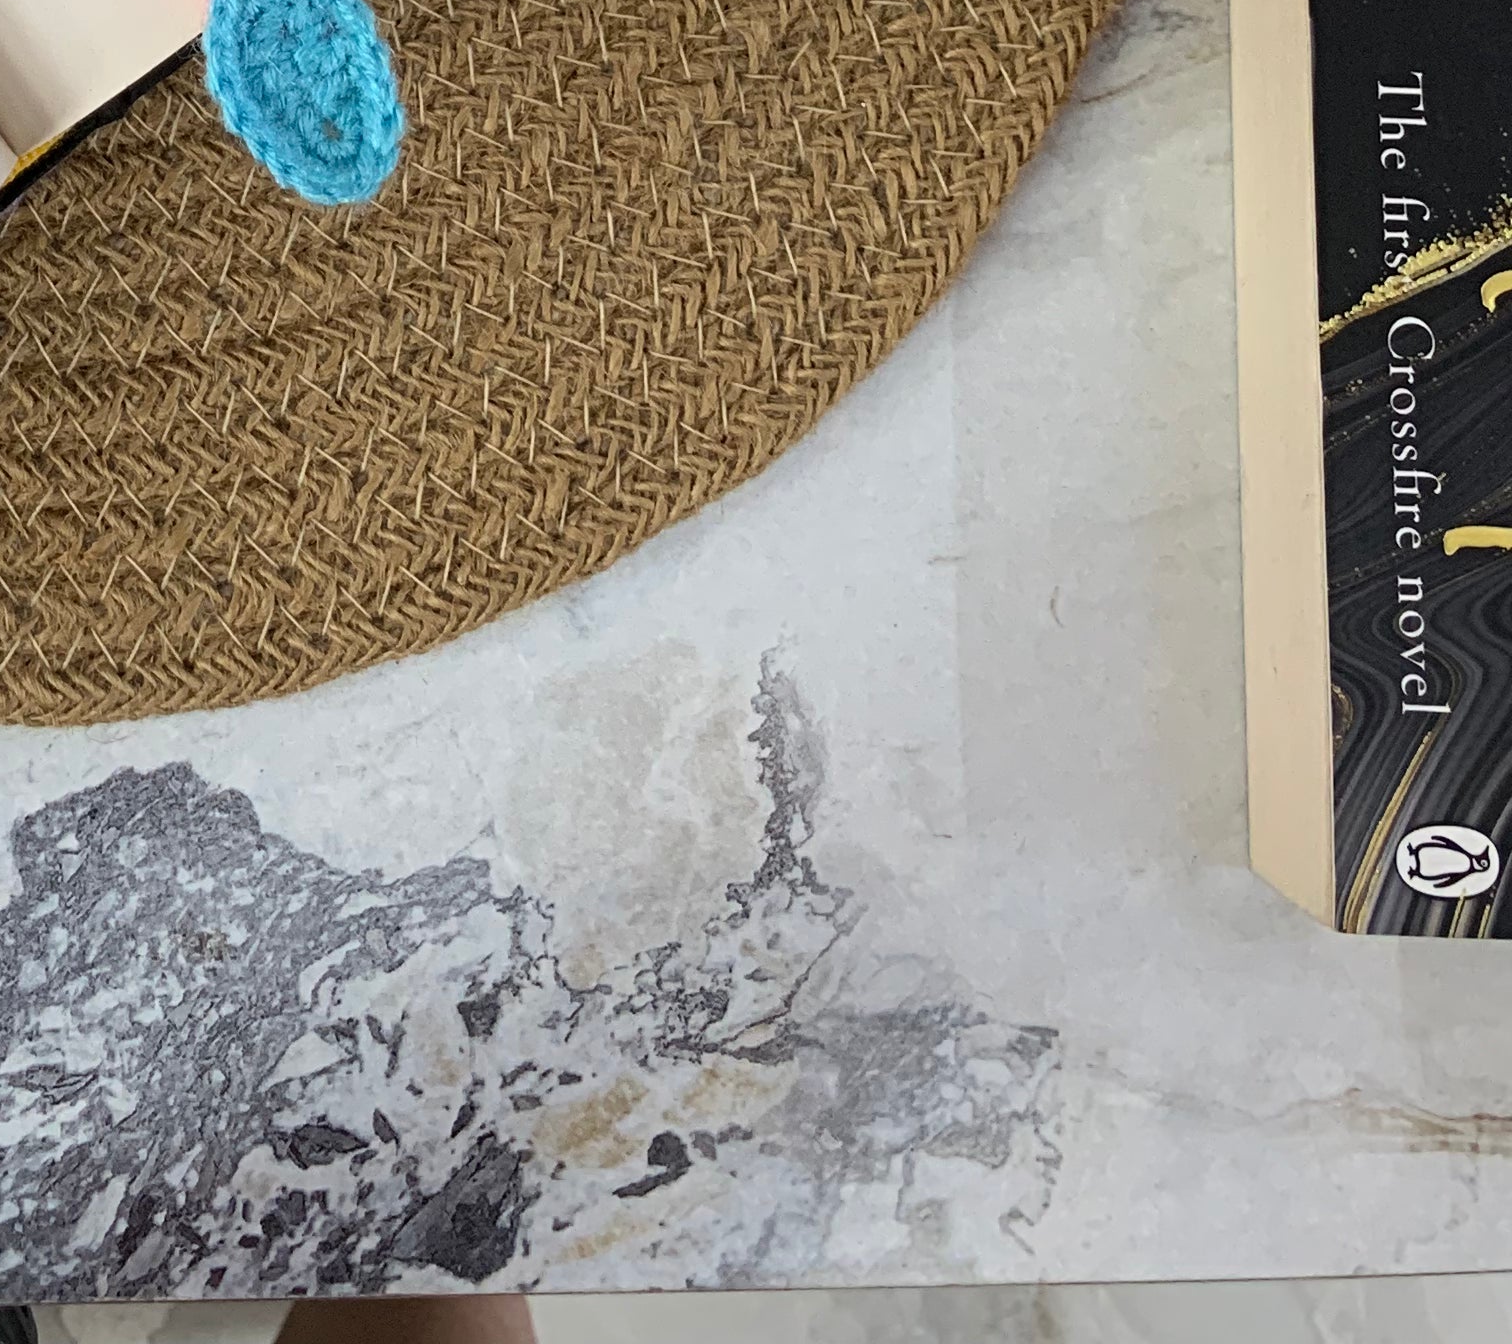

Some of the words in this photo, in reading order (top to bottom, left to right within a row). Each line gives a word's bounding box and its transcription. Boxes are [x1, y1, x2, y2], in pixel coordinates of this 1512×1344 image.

[1377, 70, 1429, 170] The
[1388, 315, 1442, 550] Crossfire
[1396, 575, 1452, 714] novel
